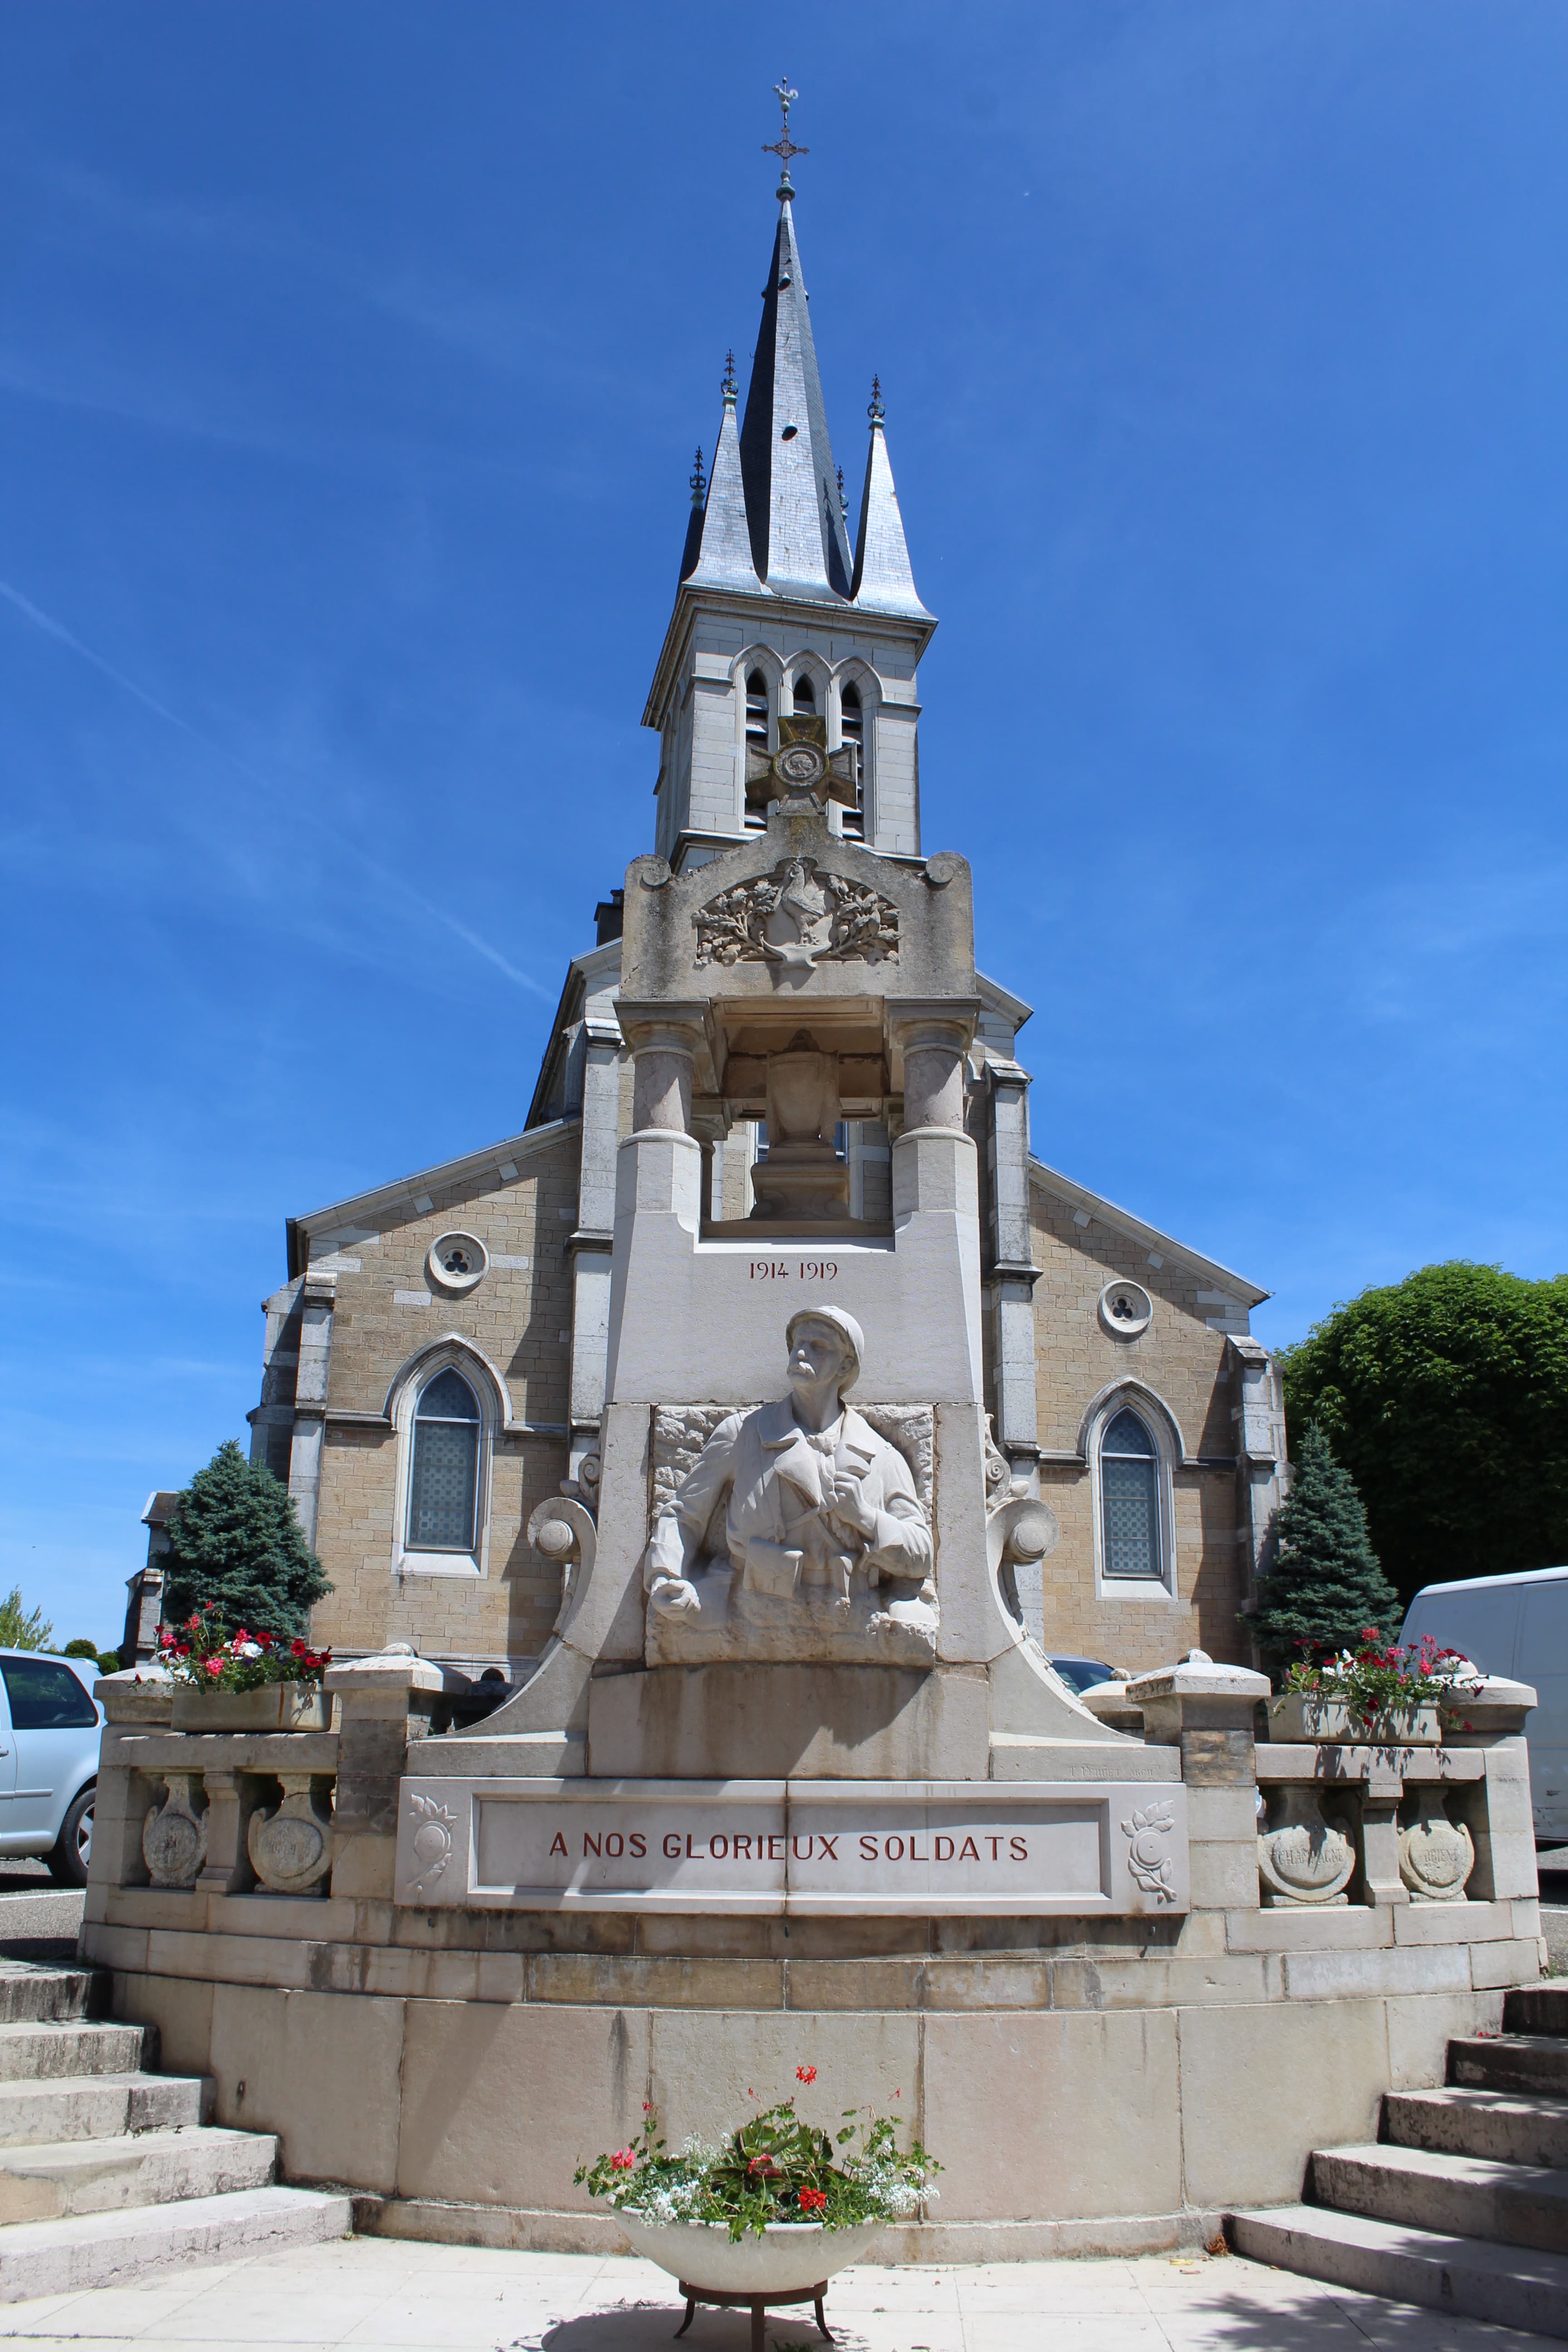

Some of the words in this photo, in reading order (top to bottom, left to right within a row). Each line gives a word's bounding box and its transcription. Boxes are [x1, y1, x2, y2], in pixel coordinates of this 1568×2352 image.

[750, 1262, 789, 1280] 1914
[799, 1262, 838, 1280] 1919
[550, 1832, 569, 1857] A
[583, 1832, 647, 1858] NOS
[662, 1833, 839, 1861] GLORIEUX
[858, 1835, 1029, 1862] SOLDATS
